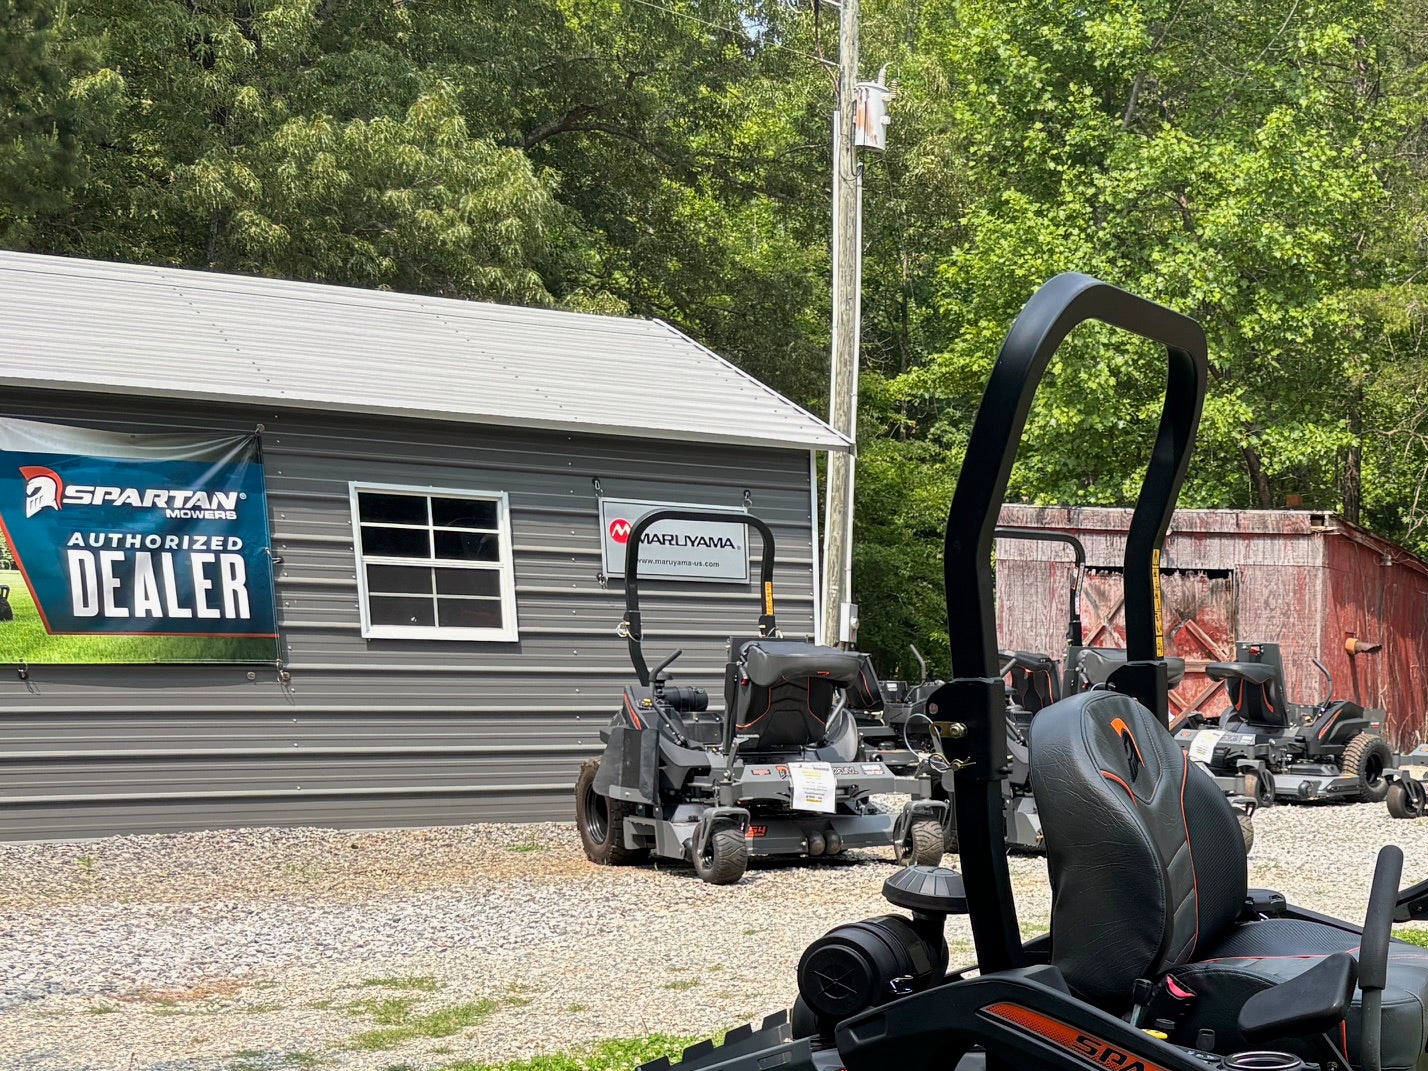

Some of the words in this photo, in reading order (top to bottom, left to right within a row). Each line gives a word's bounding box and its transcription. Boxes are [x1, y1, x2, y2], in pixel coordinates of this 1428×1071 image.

[63, 485, 237, 510] SPARTAN
[166, 509, 237, 520] MOWERS
[67, 532, 244, 551] AUTHORIZED
[639, 533, 736, 549] MARUYAMA
[67, 549, 250, 619] DEALER
